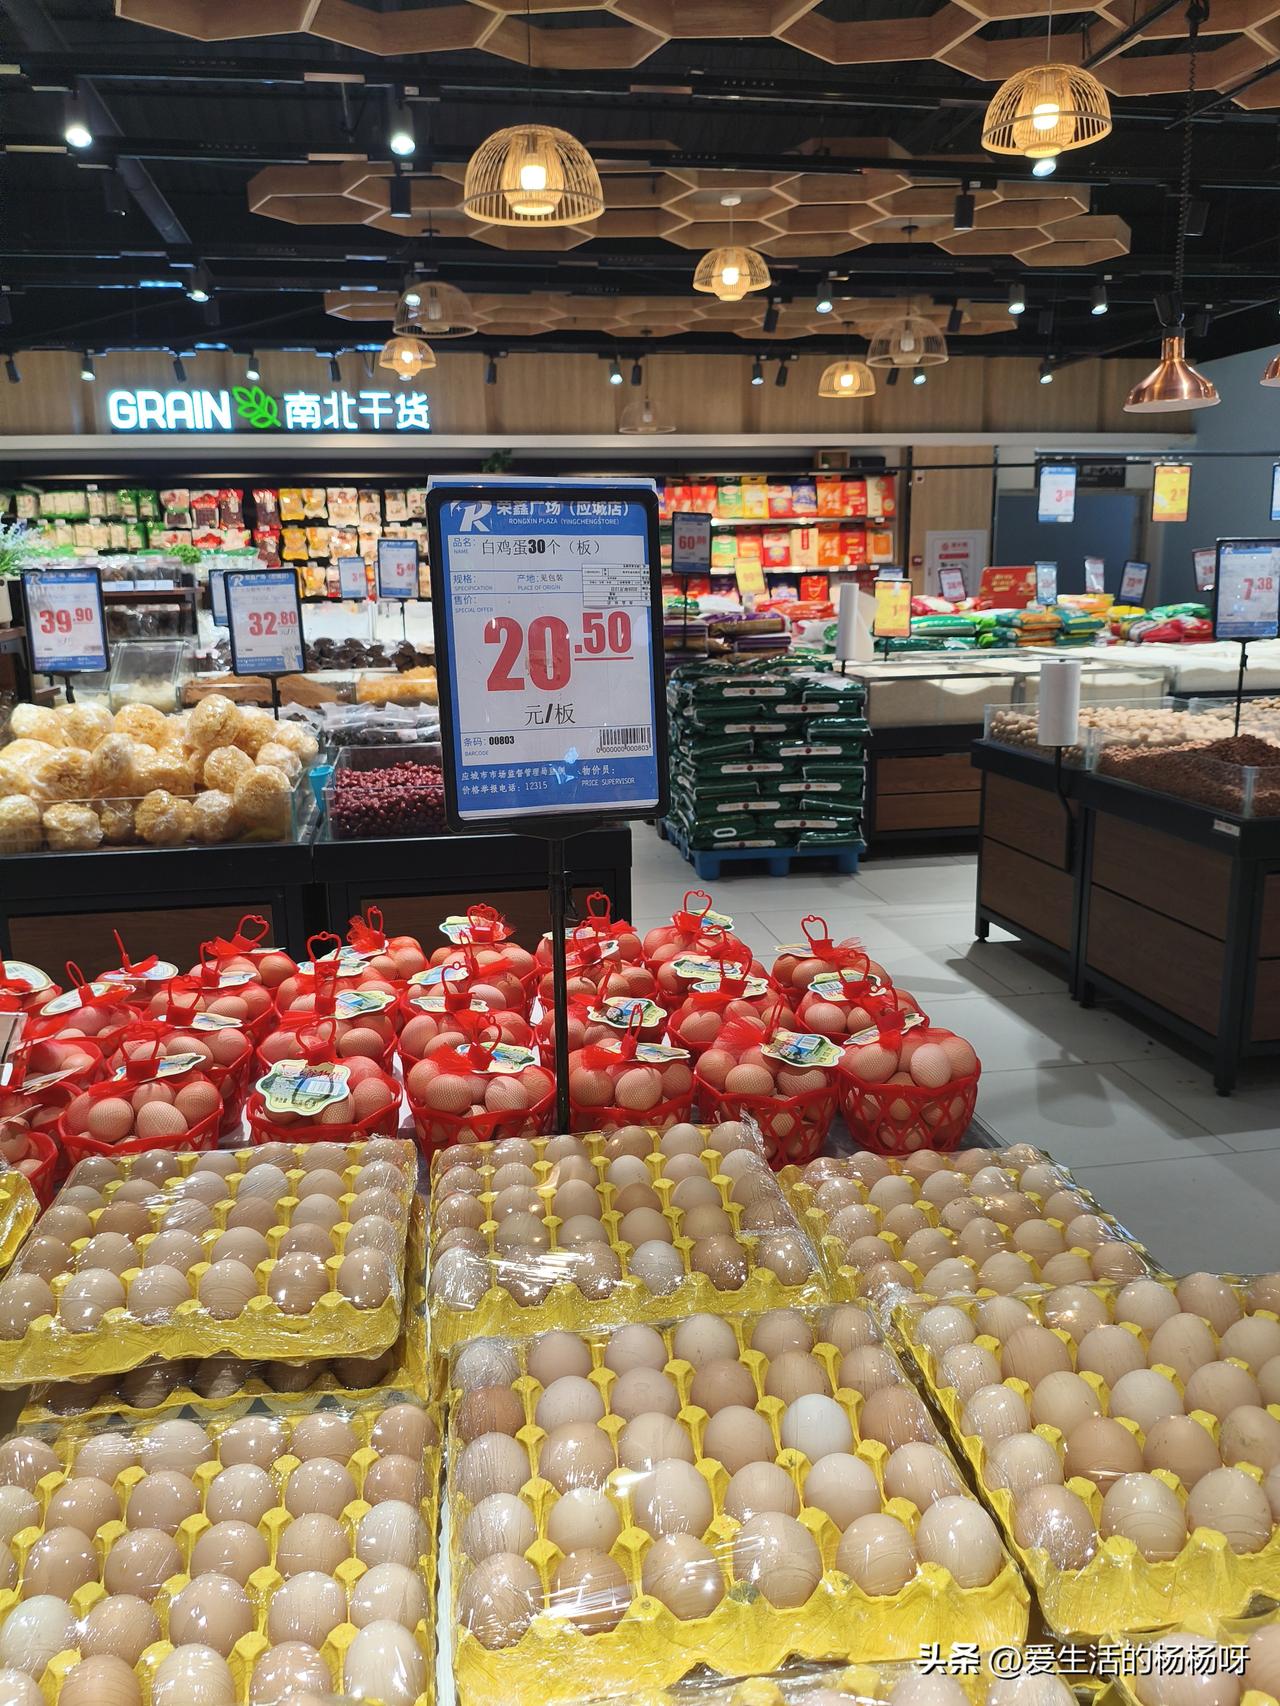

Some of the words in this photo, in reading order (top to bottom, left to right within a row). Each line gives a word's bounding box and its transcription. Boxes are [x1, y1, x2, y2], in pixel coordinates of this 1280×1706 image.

[108, 390, 232, 430] GRAIN
[283, 391, 431, 430] 南北干货
[482, 539, 600, 556] 白鸡蛋30个（板）
[39, 608, 93, 634] 39.90
[248, 611, 297, 636] 32.80
[484, 611, 632, 691] 20.50
[525, 703, 576, 726] 元/板
[488, 735, 515, 746] 00803
[525, 781, 548, 791] 12315
[581, 779, 599, 787] PRICE
[601, 777, 636, 786] SUPERVISOR
